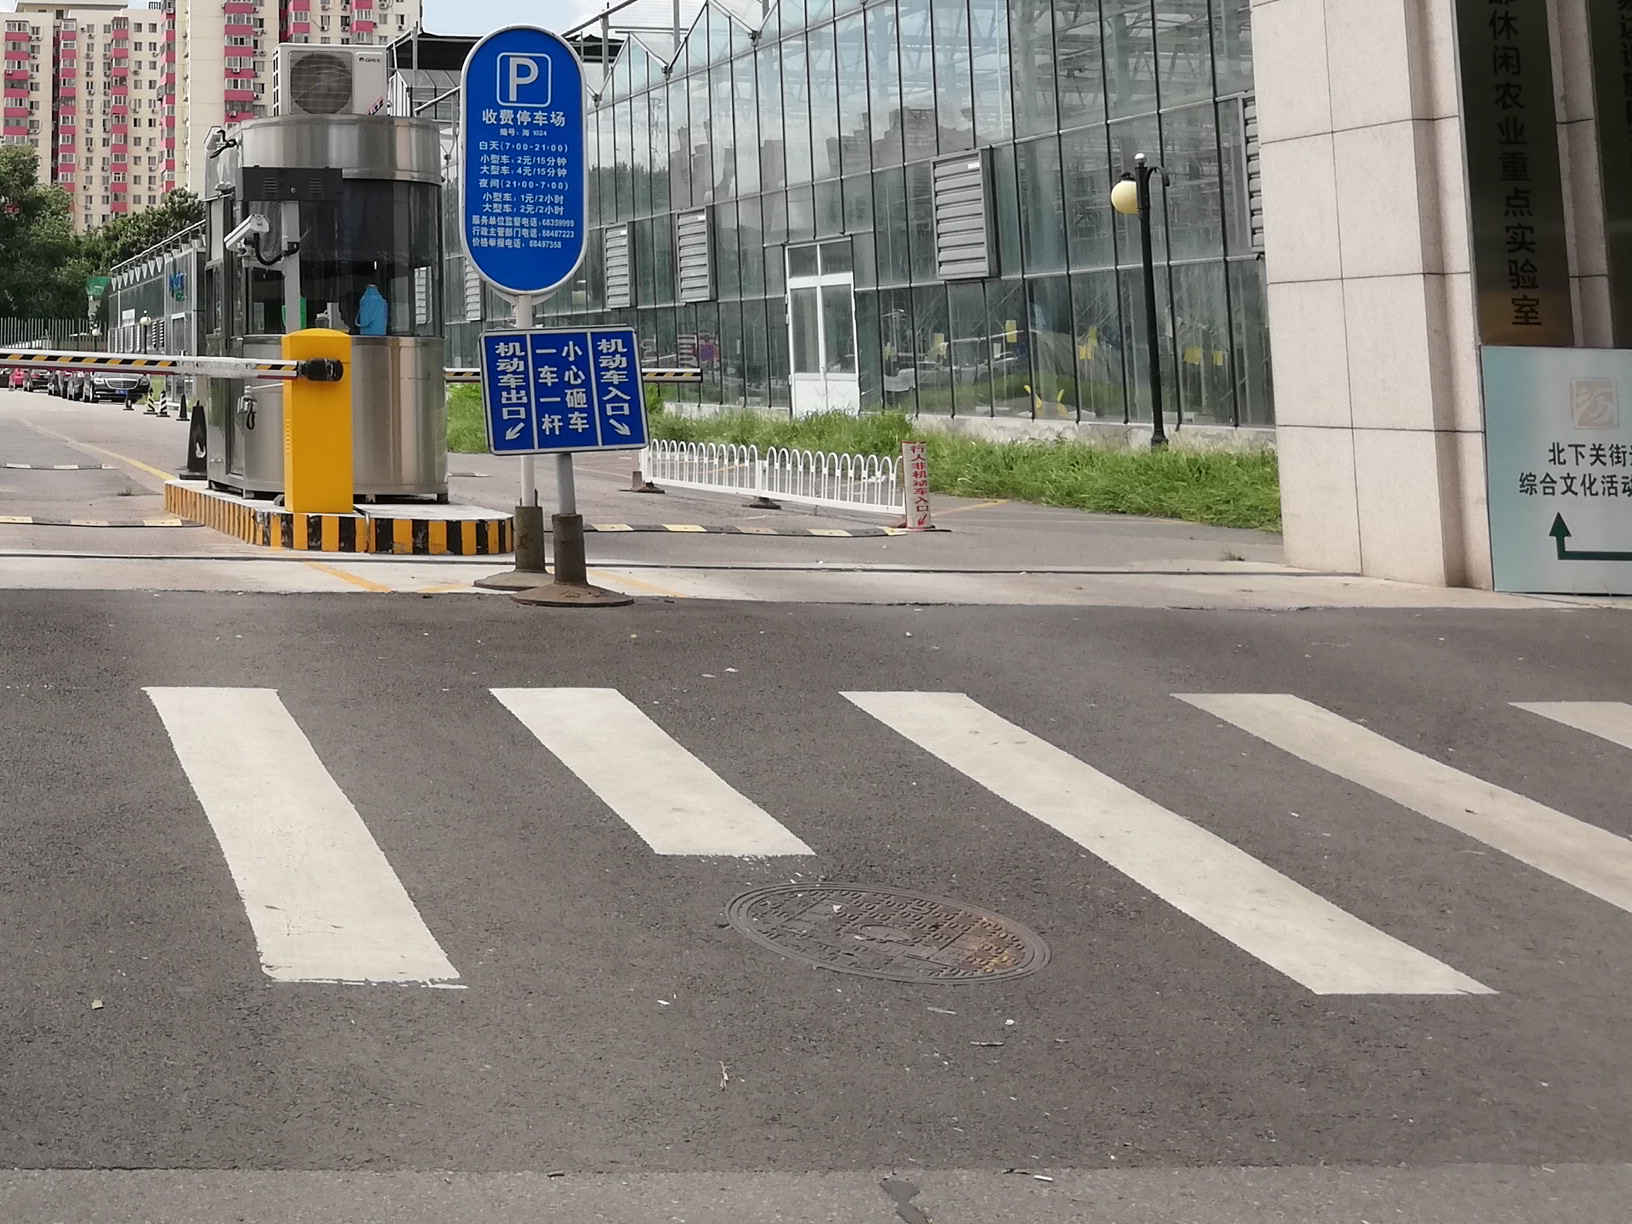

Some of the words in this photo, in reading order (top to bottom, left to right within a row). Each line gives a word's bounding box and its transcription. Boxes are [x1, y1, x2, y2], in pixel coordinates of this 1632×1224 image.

[509, 57, 539, 102] P
[482, 109, 566, 127] 收费停车场
[495, 342, 528, 420] 机动车出口
[535, 348, 563, 435] 一车一杆
[561, 341, 589, 433] 小心砸车
[597, 339, 632, 416] 机动车入口
[911, 445, 929, 512] 行人非机动车入口
[1548, 441, 1632, 467] 北下关街
